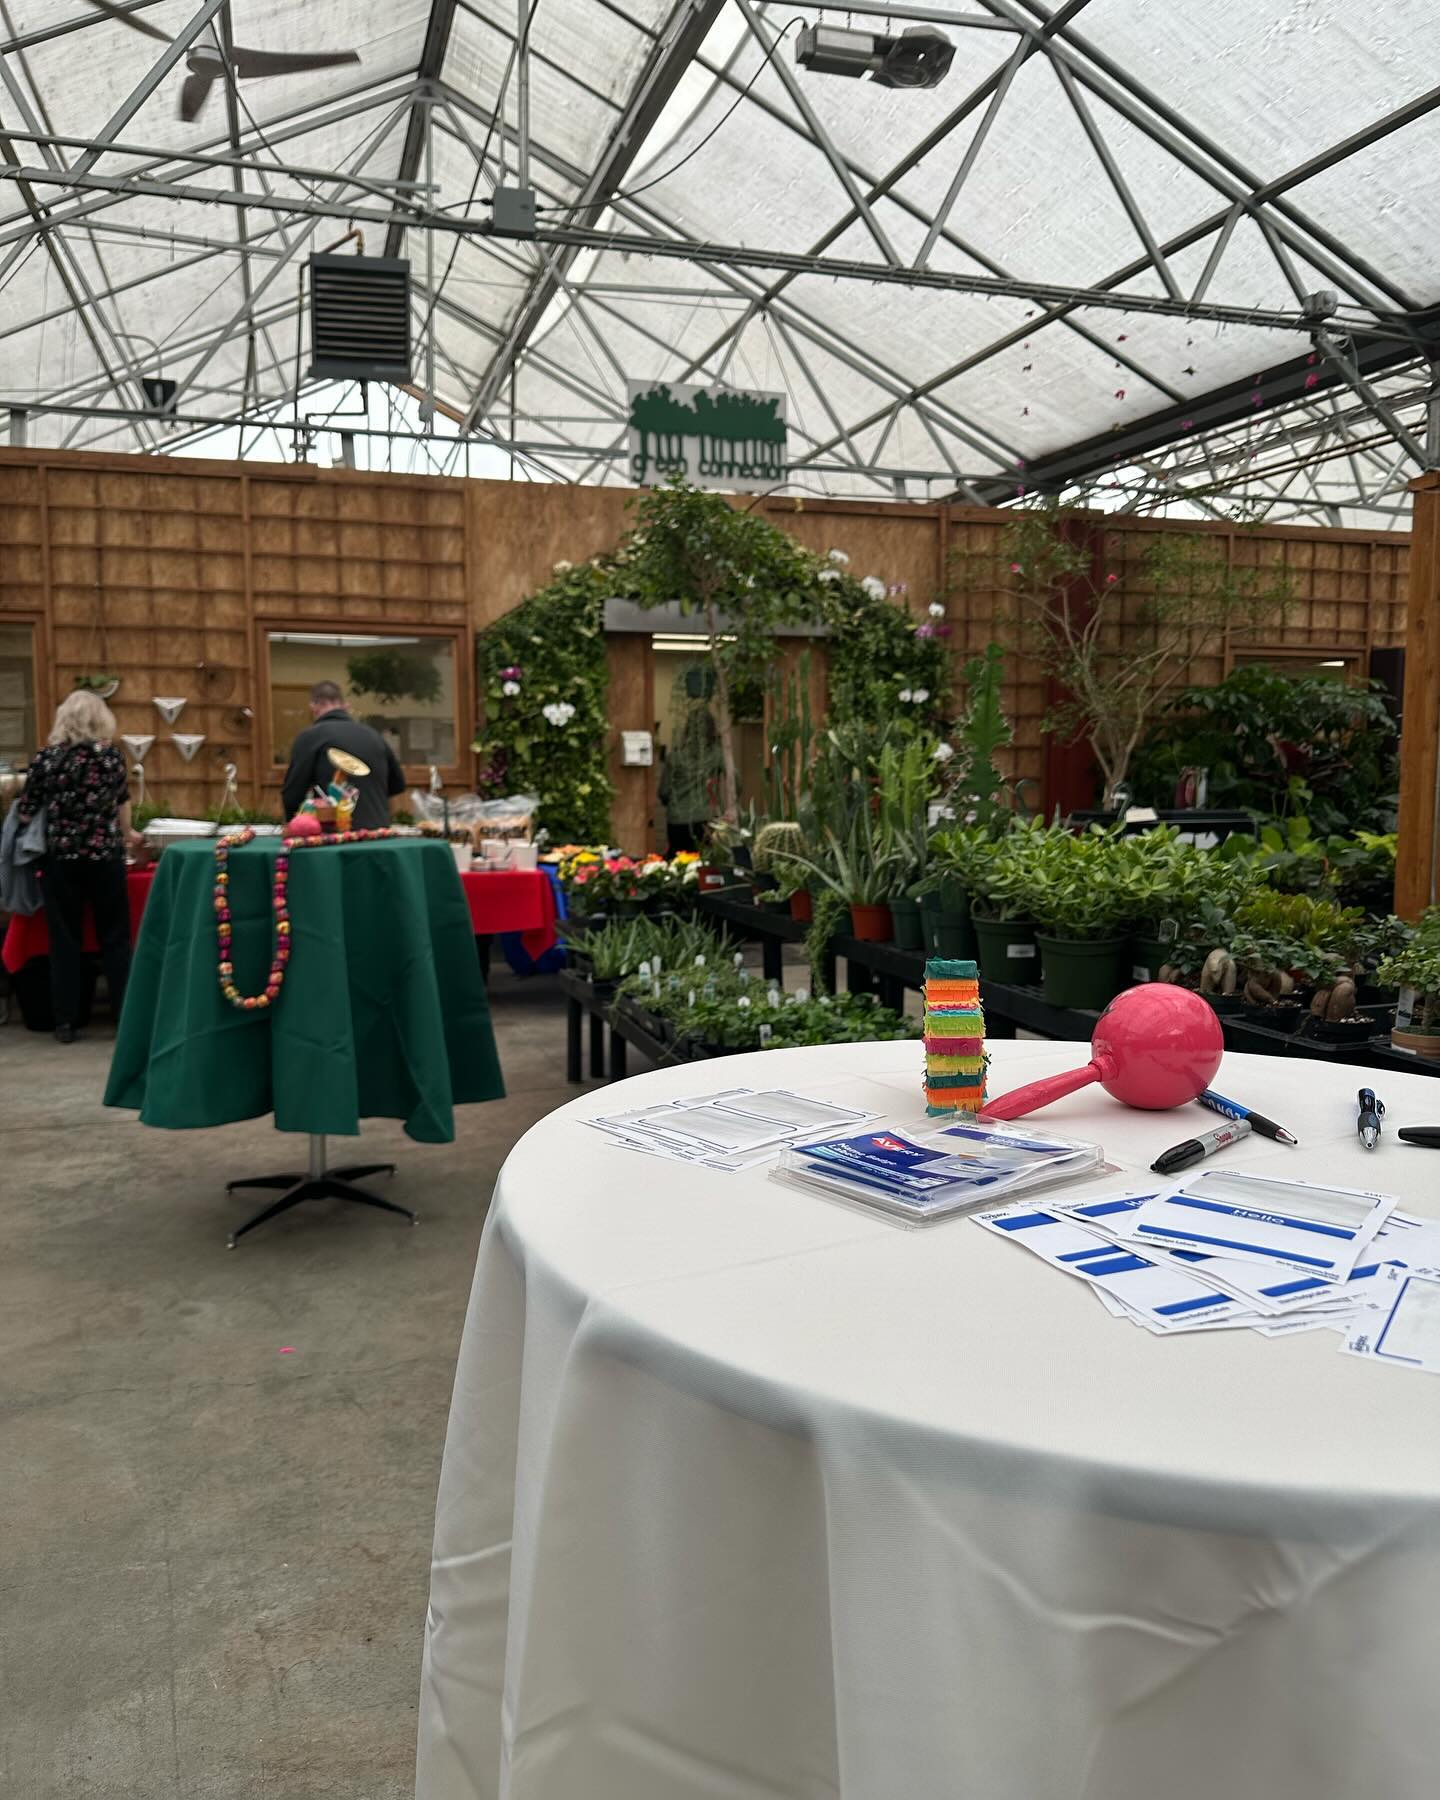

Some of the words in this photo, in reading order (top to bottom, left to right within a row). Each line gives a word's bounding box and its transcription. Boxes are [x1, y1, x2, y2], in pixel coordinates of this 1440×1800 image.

[632, 453, 688, 483] green
[698, 458, 789, 481] connection
[1232, 1209, 1285, 1225] Hello
